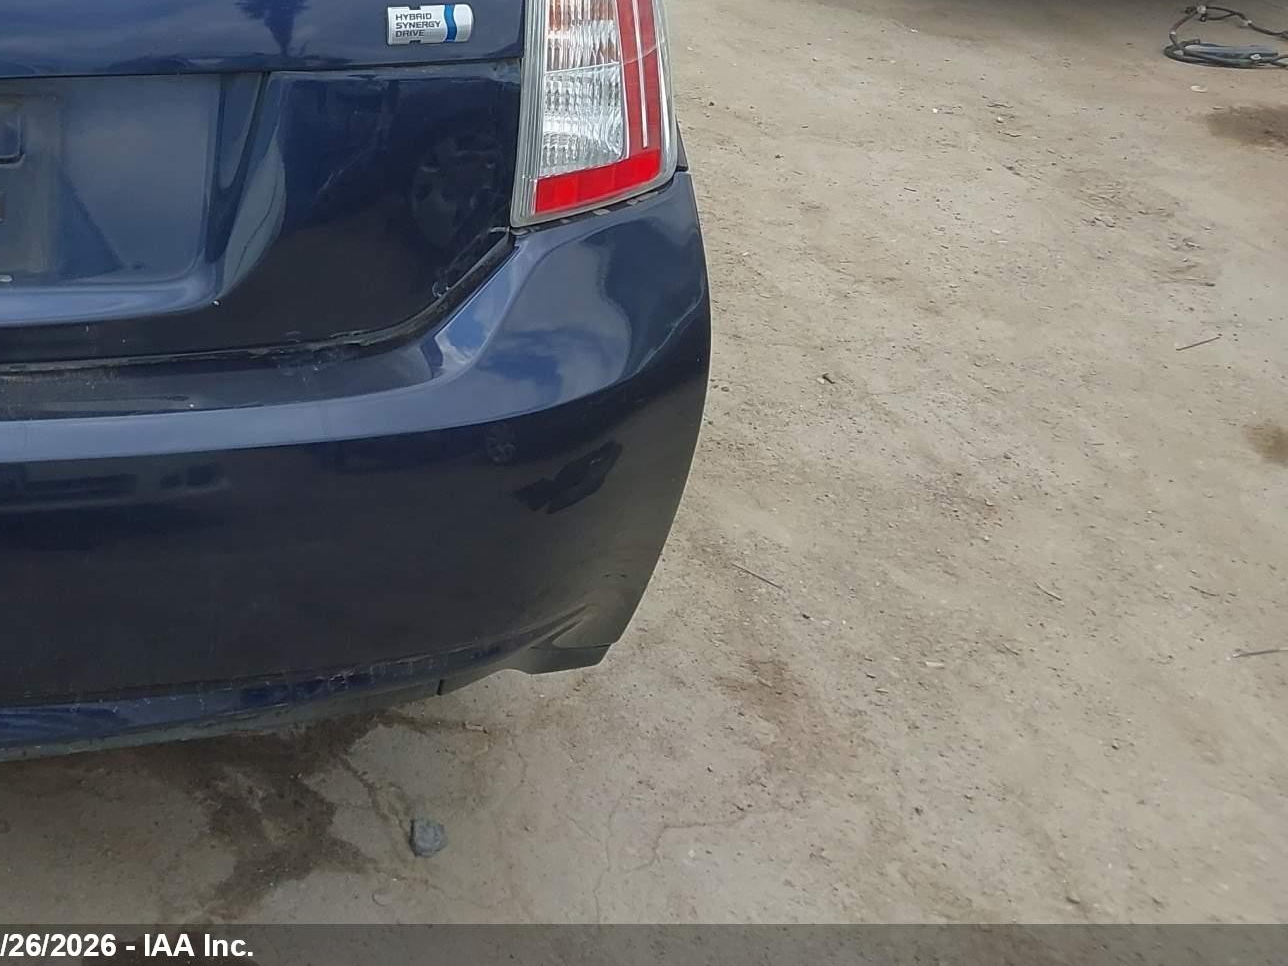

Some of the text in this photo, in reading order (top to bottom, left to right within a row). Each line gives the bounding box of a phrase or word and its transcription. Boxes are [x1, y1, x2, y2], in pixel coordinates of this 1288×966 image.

[395, 13, 432, 21] HYBRID
[395, 20, 441, 29] SYNERGY
[395, 29, 425, 38] DRIVE
